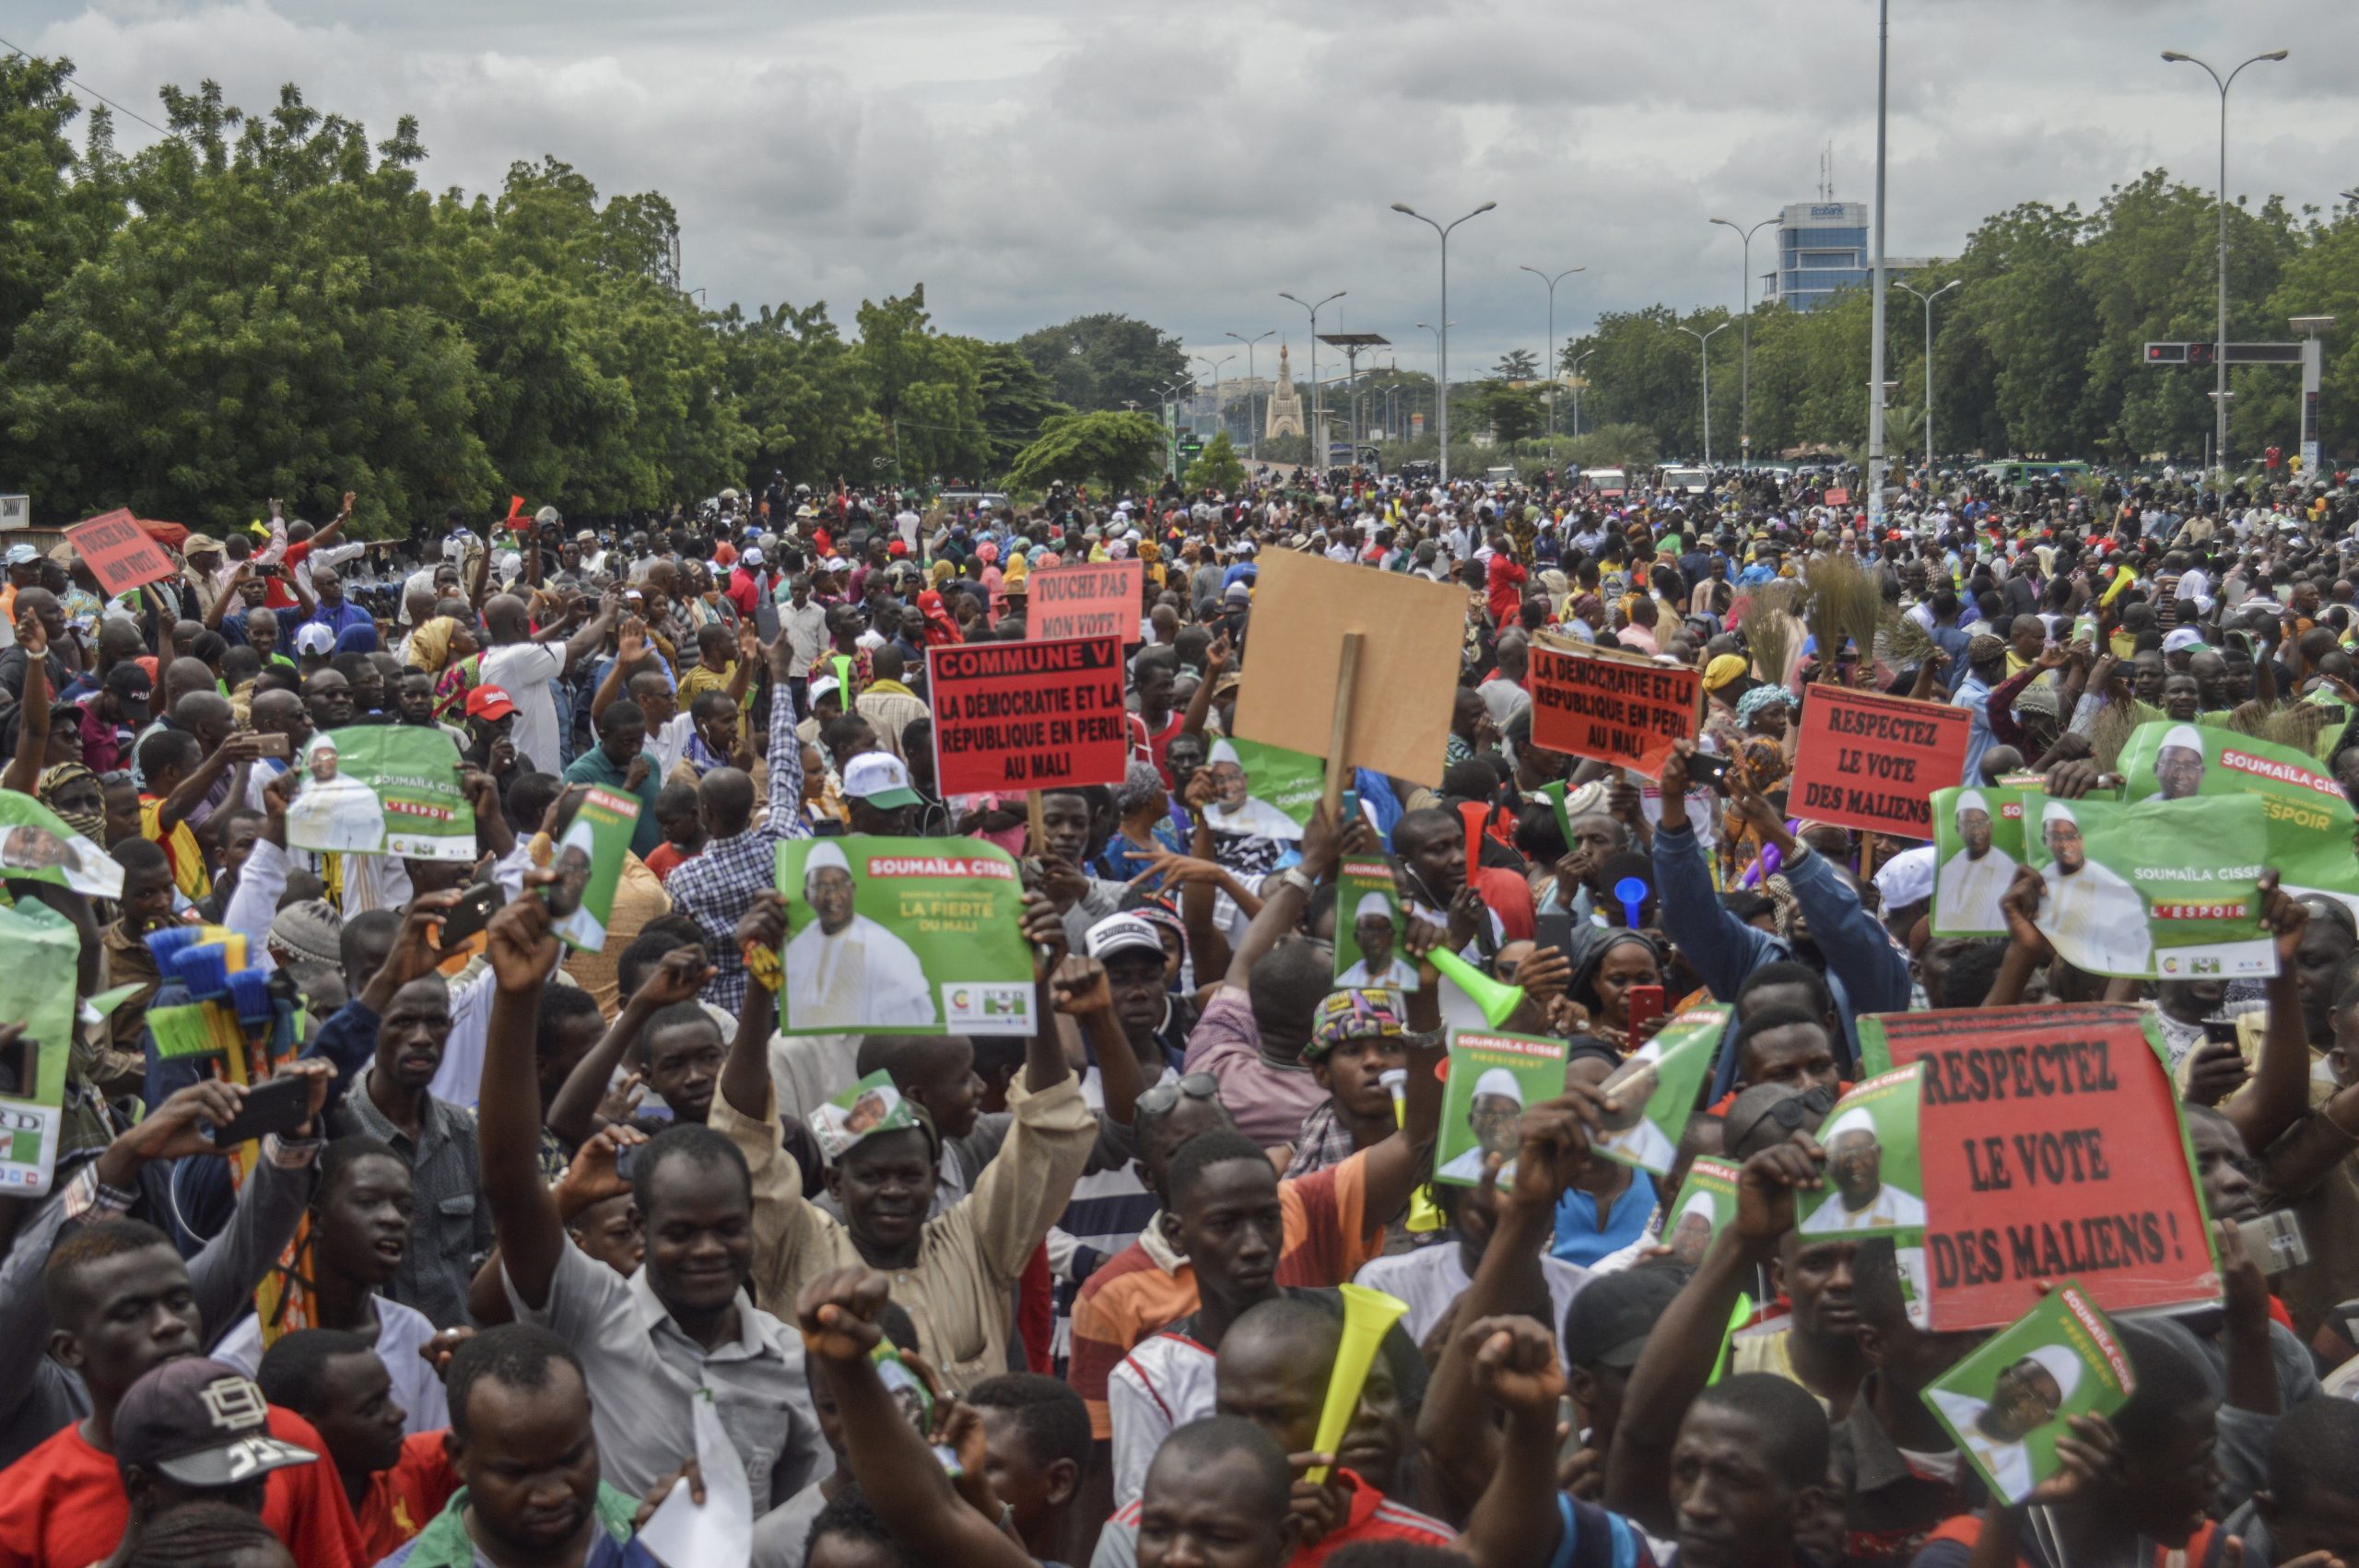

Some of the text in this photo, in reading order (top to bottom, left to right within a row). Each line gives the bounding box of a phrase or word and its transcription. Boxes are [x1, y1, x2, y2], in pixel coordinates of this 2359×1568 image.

[1812, 206, 1844, 215] Ecobank
[1039, 572, 1128, 602] TOUCHE PAS
[1041, 615, 1074, 638] MON
[1077, 613, 1116, 636] VOTE
[939, 641, 1110, 677] COMMUNE V
[1534, 653, 1553, 679] LA
[1653, 673, 1672, 701] ET
[1676, 680, 1693, 706] LA
[939, 683, 1121, 720] LA DÉMOCRATIE ET LA
[941, 716, 1124, 754] RÉPUBLIQUE EN PERIL
[1628, 703, 1648, 728] EN
[1652, 708, 1687, 739] PERIL
[1828, 708, 1939, 747] RESPECTEZ
[1588, 724, 1644, 760] AU MALI
[1004, 753, 1071, 779] AU MALI
[1837, 748, 1917, 783] LE VOTE
[2223, 752, 2310, 786] SOUMAÏLA
[374, 774, 463, 797] SOUMAÏLA CISS
[385, 801, 454, 821] L'ESPOIR
[1804, 782, 1931, 825] DES MALIENS
[871, 858, 966, 874] SOUMAÏLA
[2134, 867, 2212, 882] SOUMAÏLA
[900, 902, 926, 918] LA
[919, 919, 978, 932] DU MALI
[2150, 905, 2247, 919] L'ESPOIR
[1458, 1035, 1522, 1051] SOUMAÏLA
[1918, 1039, 2118, 1106] RESPECTEZ
[1964, 1128, 2109, 1192] LE VOTE
[1929, 1228, 2003, 1289] DES
[2006, 1211, 2165, 1281] MALIENS
